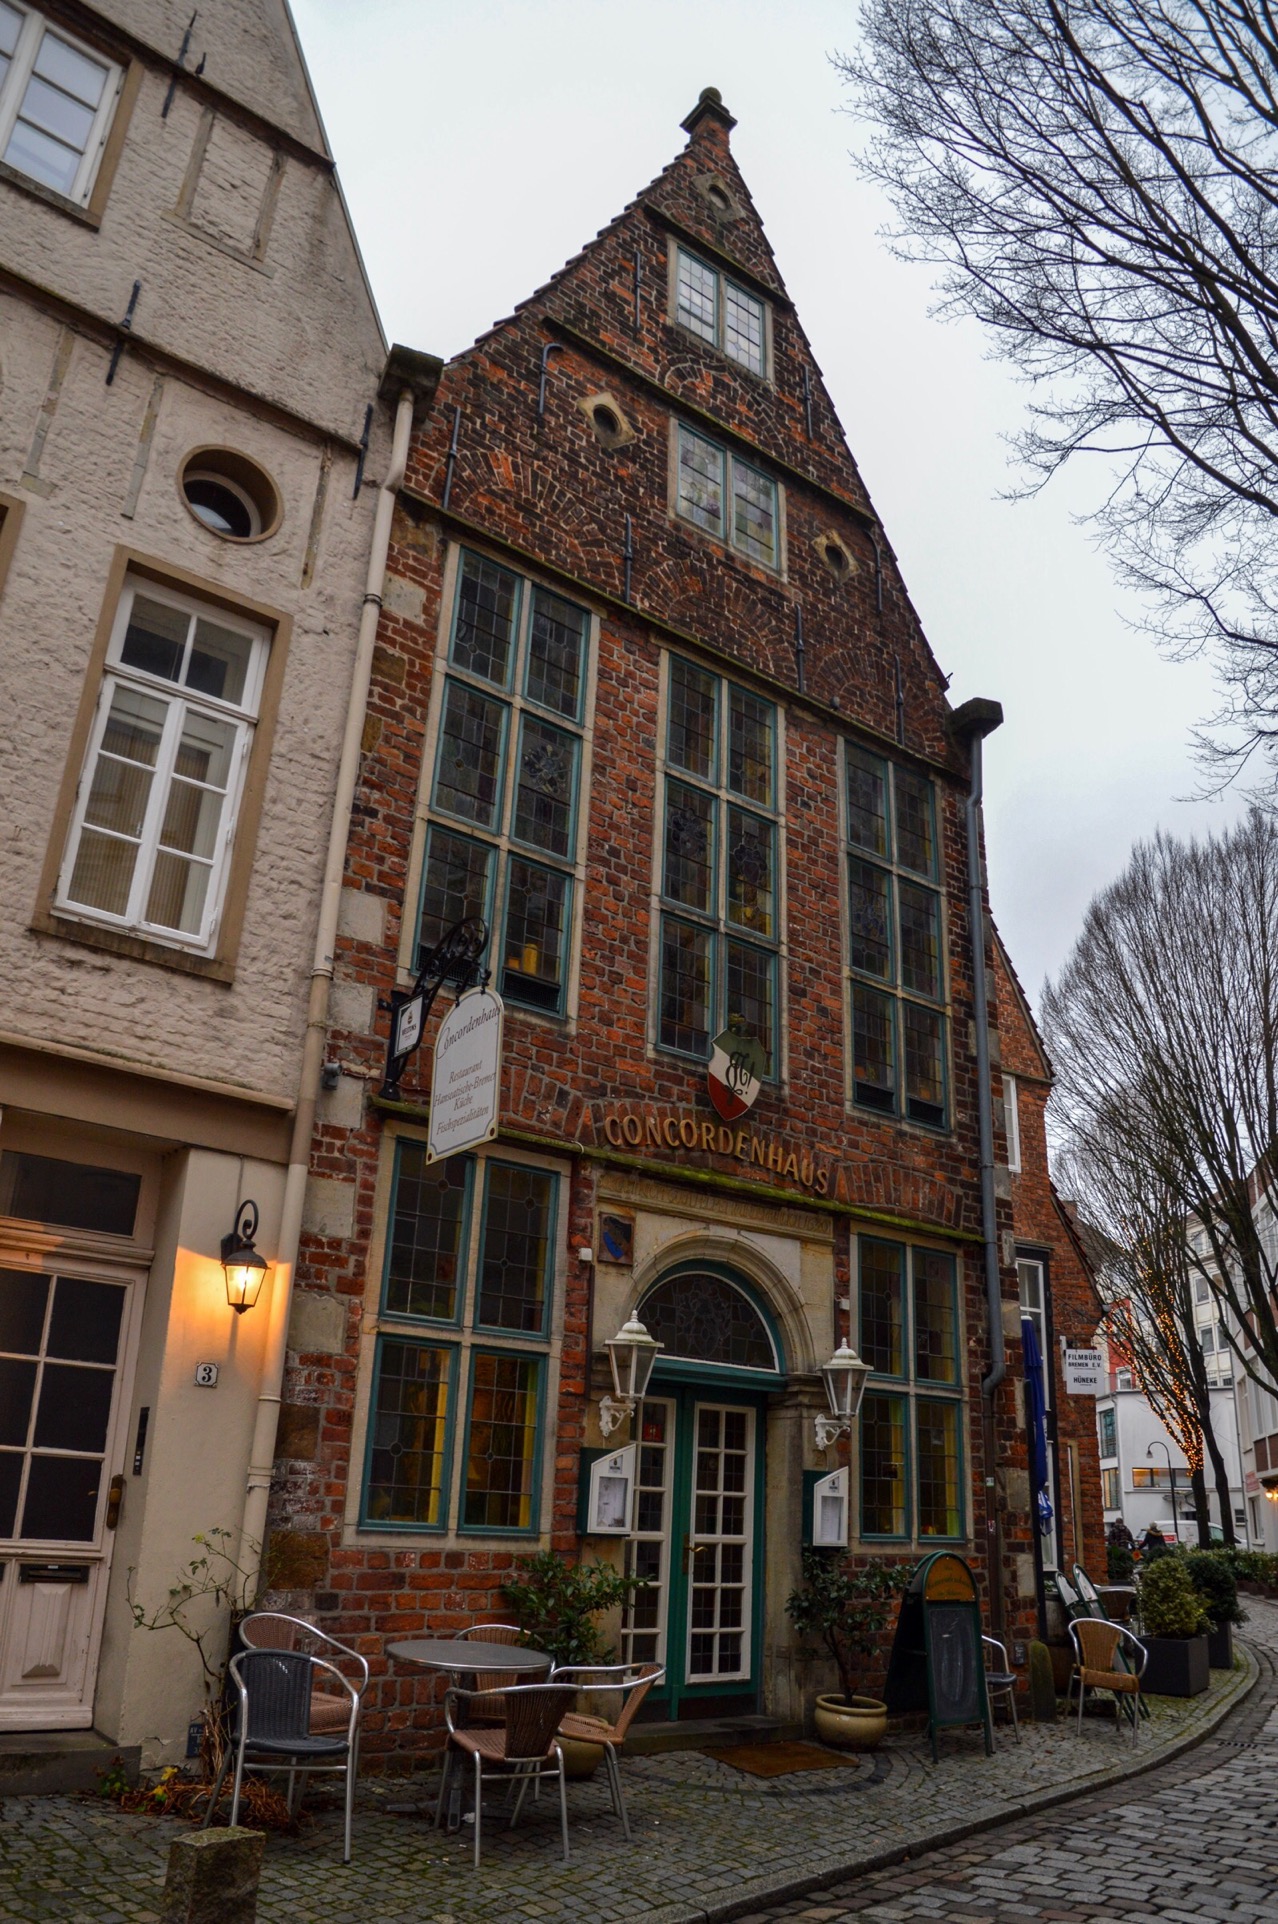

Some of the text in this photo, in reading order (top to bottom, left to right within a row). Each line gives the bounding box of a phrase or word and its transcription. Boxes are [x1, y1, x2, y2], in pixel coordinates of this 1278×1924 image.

[437, 1007, 500, 1059] Concordenhaus
[449, 1060, 482, 1084] Restaurant
[454, 1093, 473, 1111] Küche
[437, 1106, 489, 1135] Fischspezialitäten
[605, 1115, 829, 1194] CONCORDENHAUS
[1068, 1353, 1102, 1361] FILMBÜRO
[202, 1366, 212, 1383] 3
[1073, 1375, 1097, 1384] HÜNEKE
